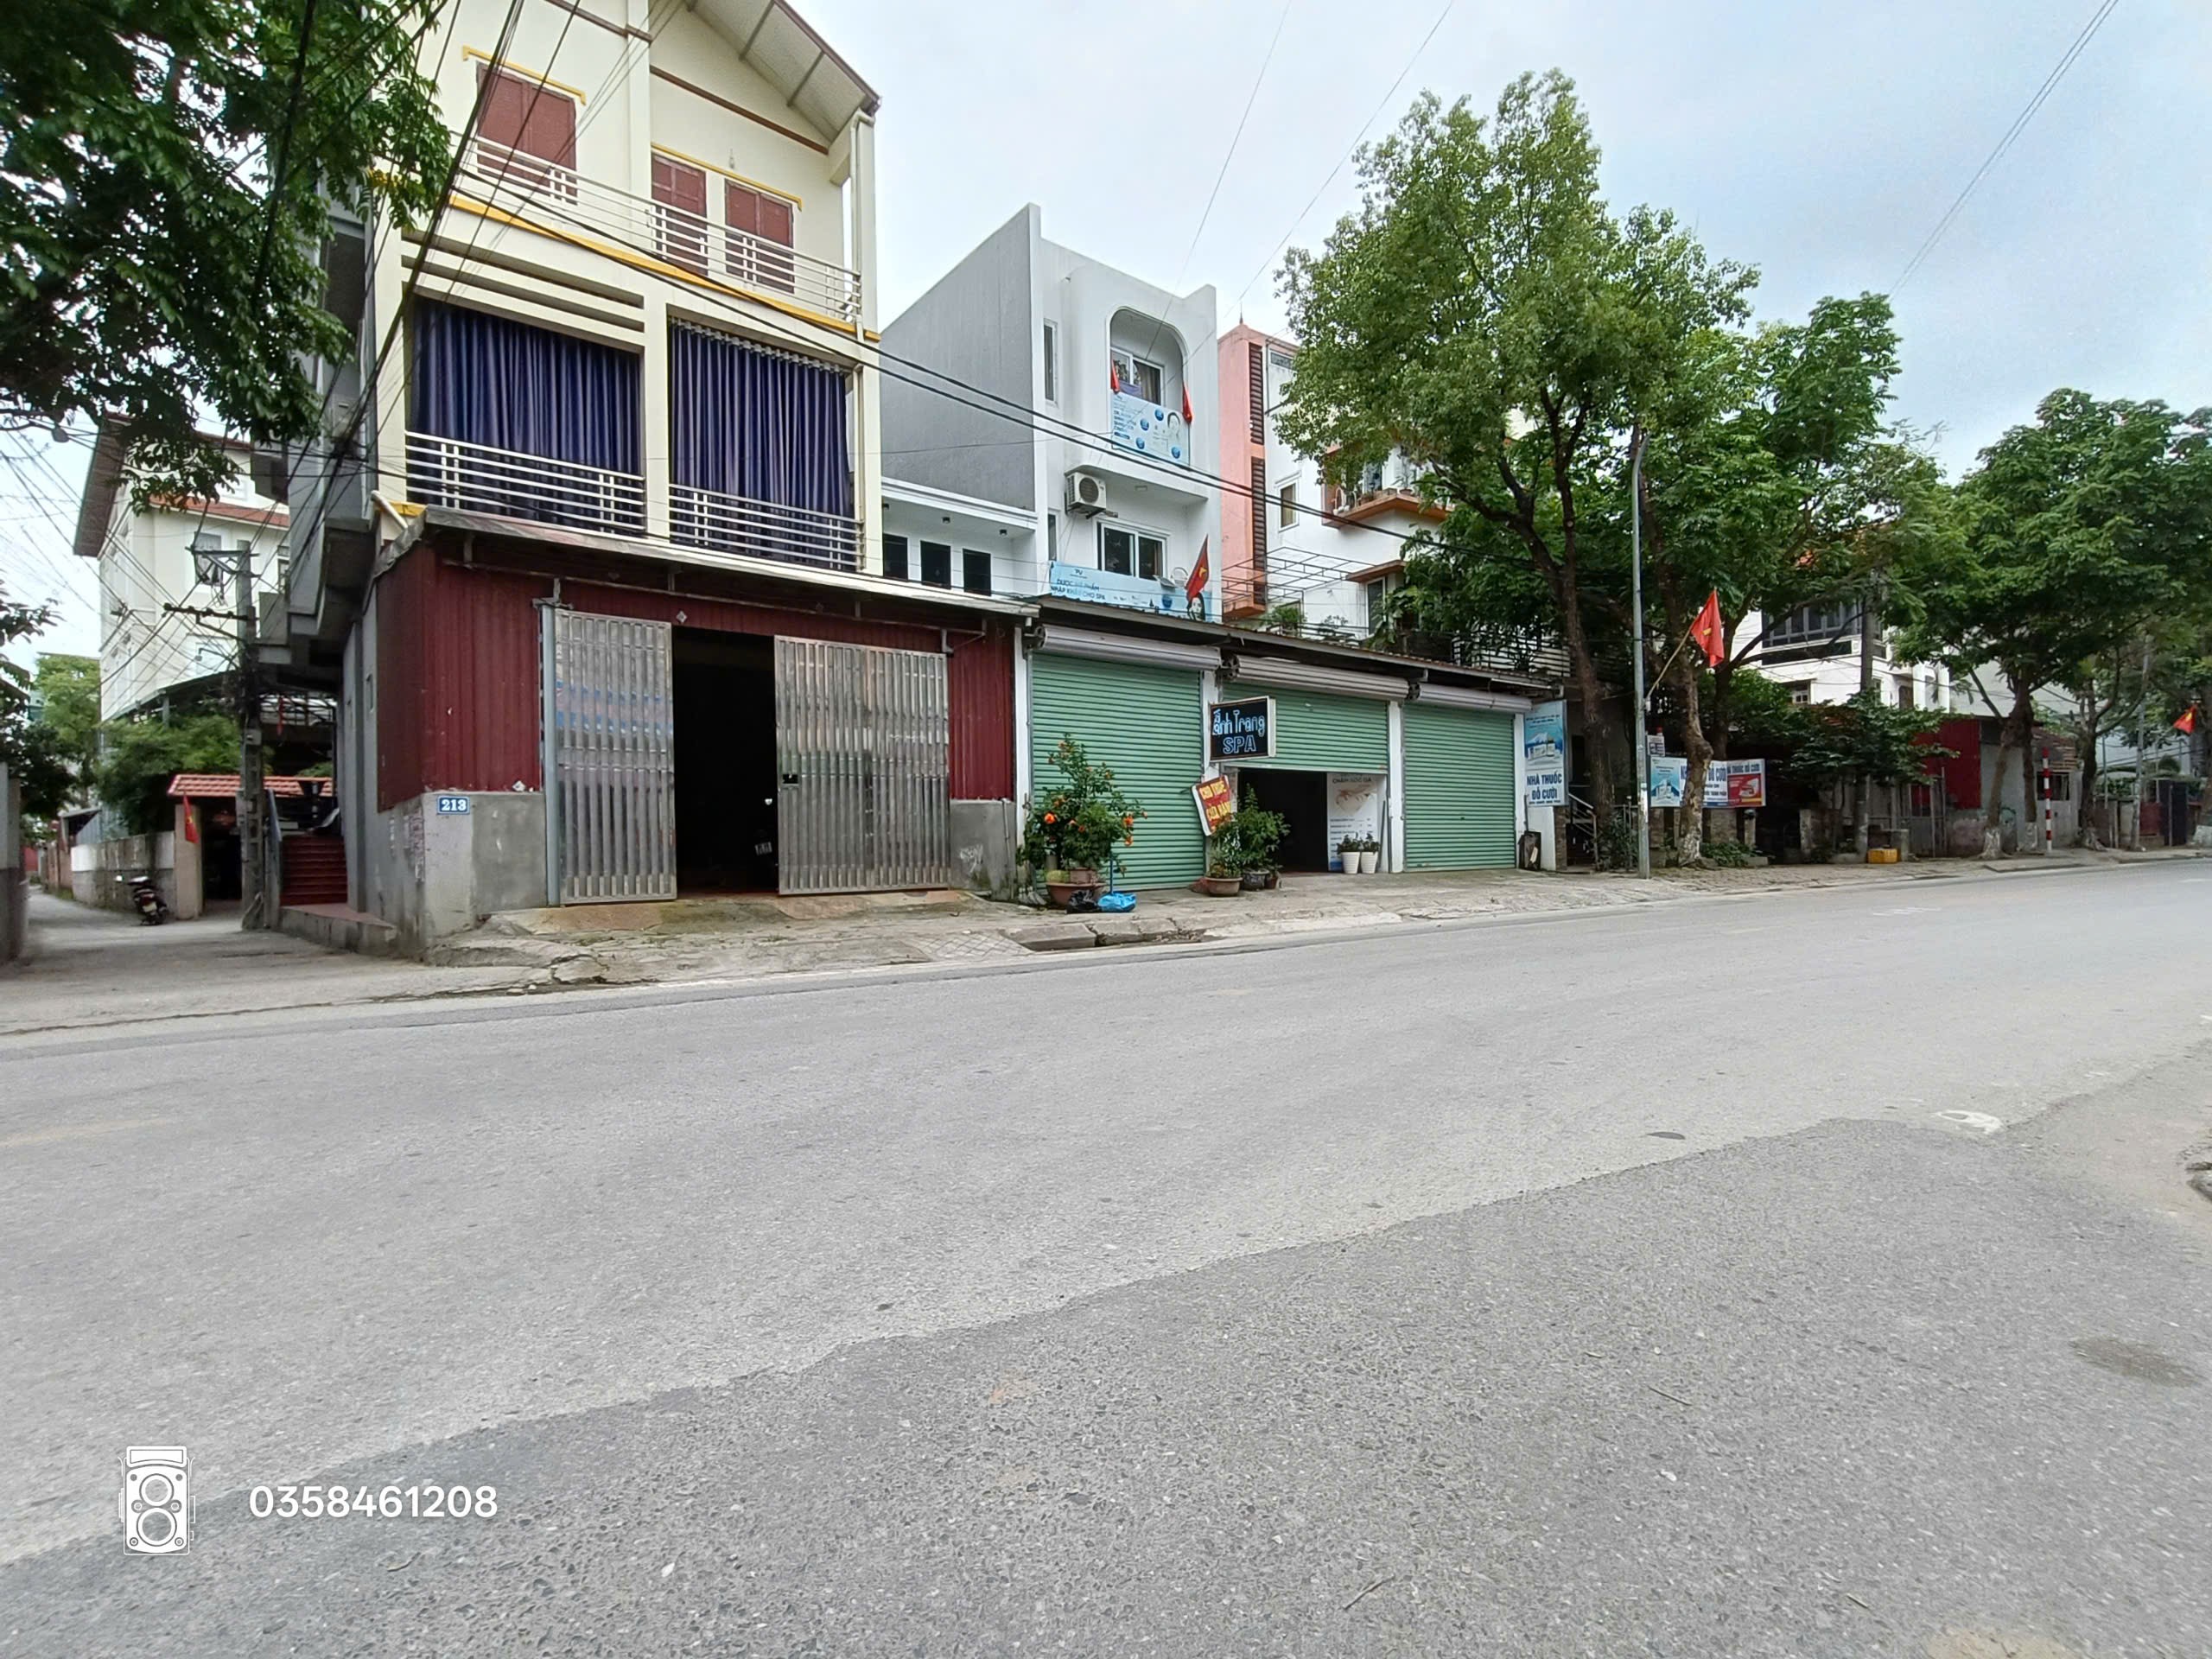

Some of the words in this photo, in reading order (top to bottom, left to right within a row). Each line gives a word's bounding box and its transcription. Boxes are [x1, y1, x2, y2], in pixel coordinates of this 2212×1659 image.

[1223, 734, 1257, 754] SPA
[1527, 772, 1541, 785] NHÀ
[1541, 770, 1562, 785] THUỐC
[442, 798, 467, 811] 213
